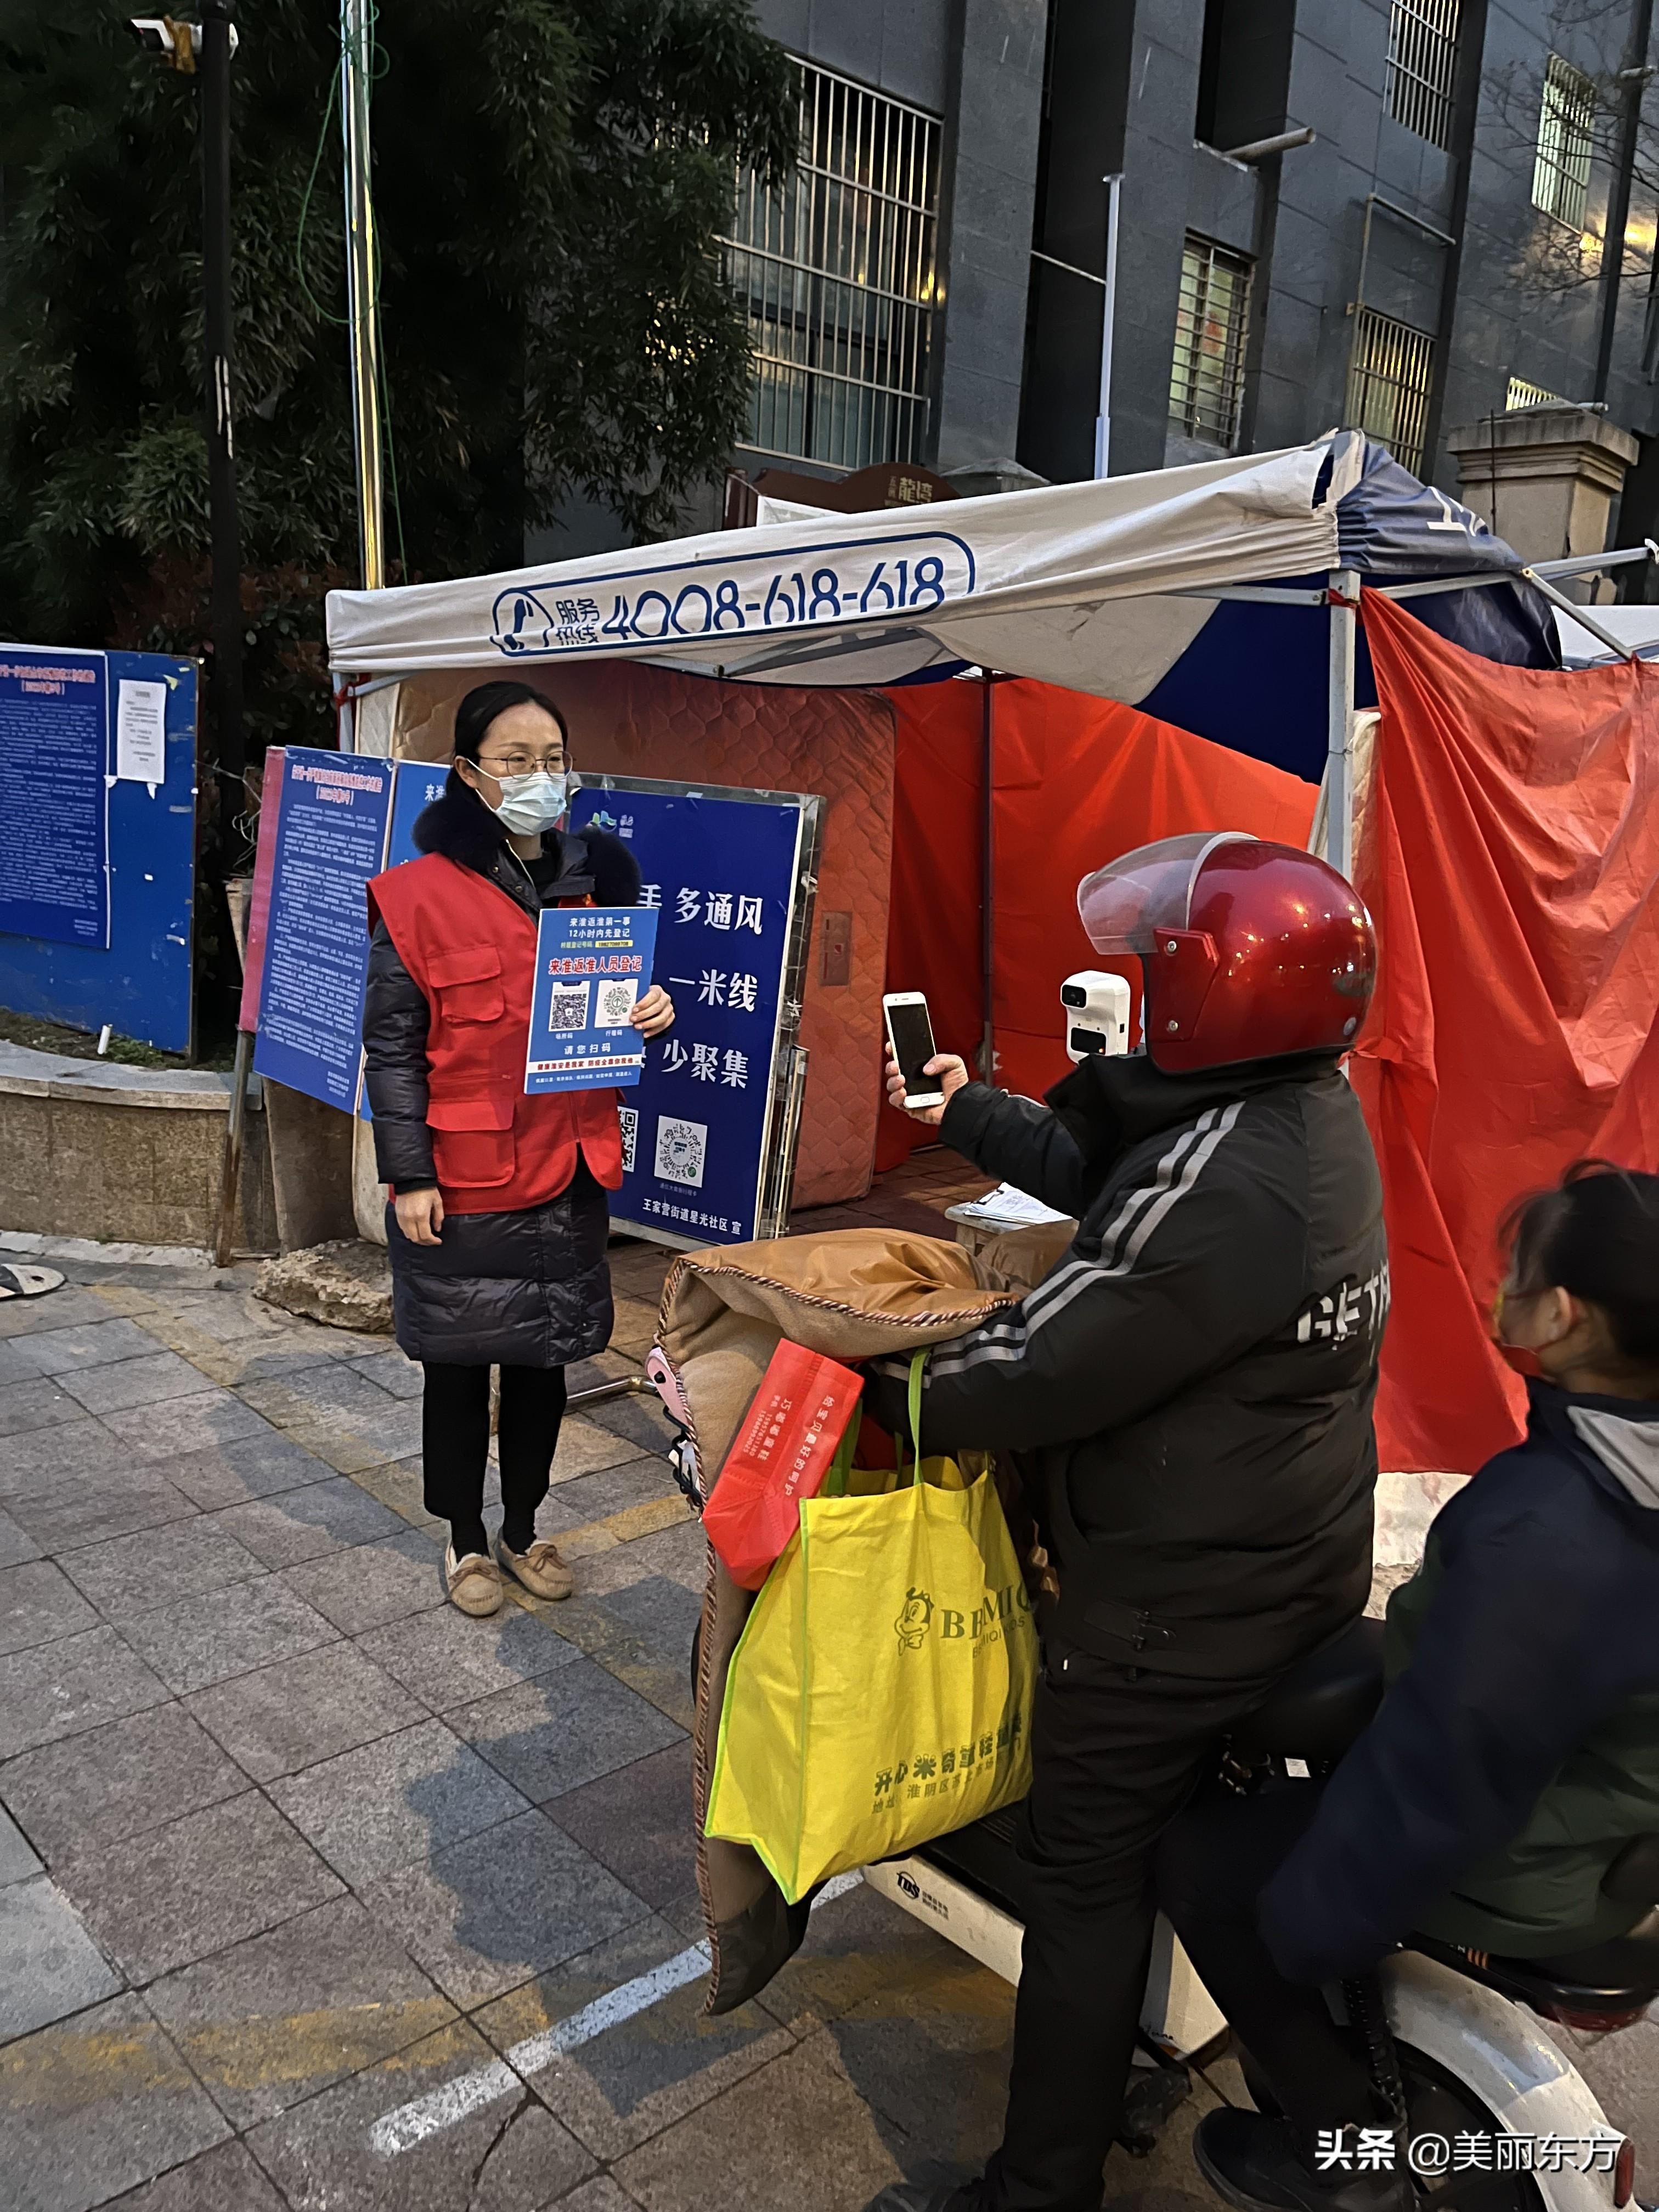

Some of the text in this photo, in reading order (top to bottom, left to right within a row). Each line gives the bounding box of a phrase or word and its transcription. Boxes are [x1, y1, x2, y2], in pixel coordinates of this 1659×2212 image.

[556, 598, 600, 624] 服务
[602, 556, 945, 640] 4008-618-618
[568, 917, 631, 927] 来淮返淮第一事
[674, 887, 763, 934] 多通风
[568, 928, 630, 938] 12小时内先登记
[549, 955, 643, 975] 来淮返淮人员登记
[669, 969, 758, 1012] 一米线
[564, 1042, 611, 1055] 请您扫码
[661, 1039, 749, 1089] 少聚集
[642, 1198, 742, 1235] 王家营街道星光社区 宣
[785, 1395, 835, 1496] 给宝贝最好的呵护
